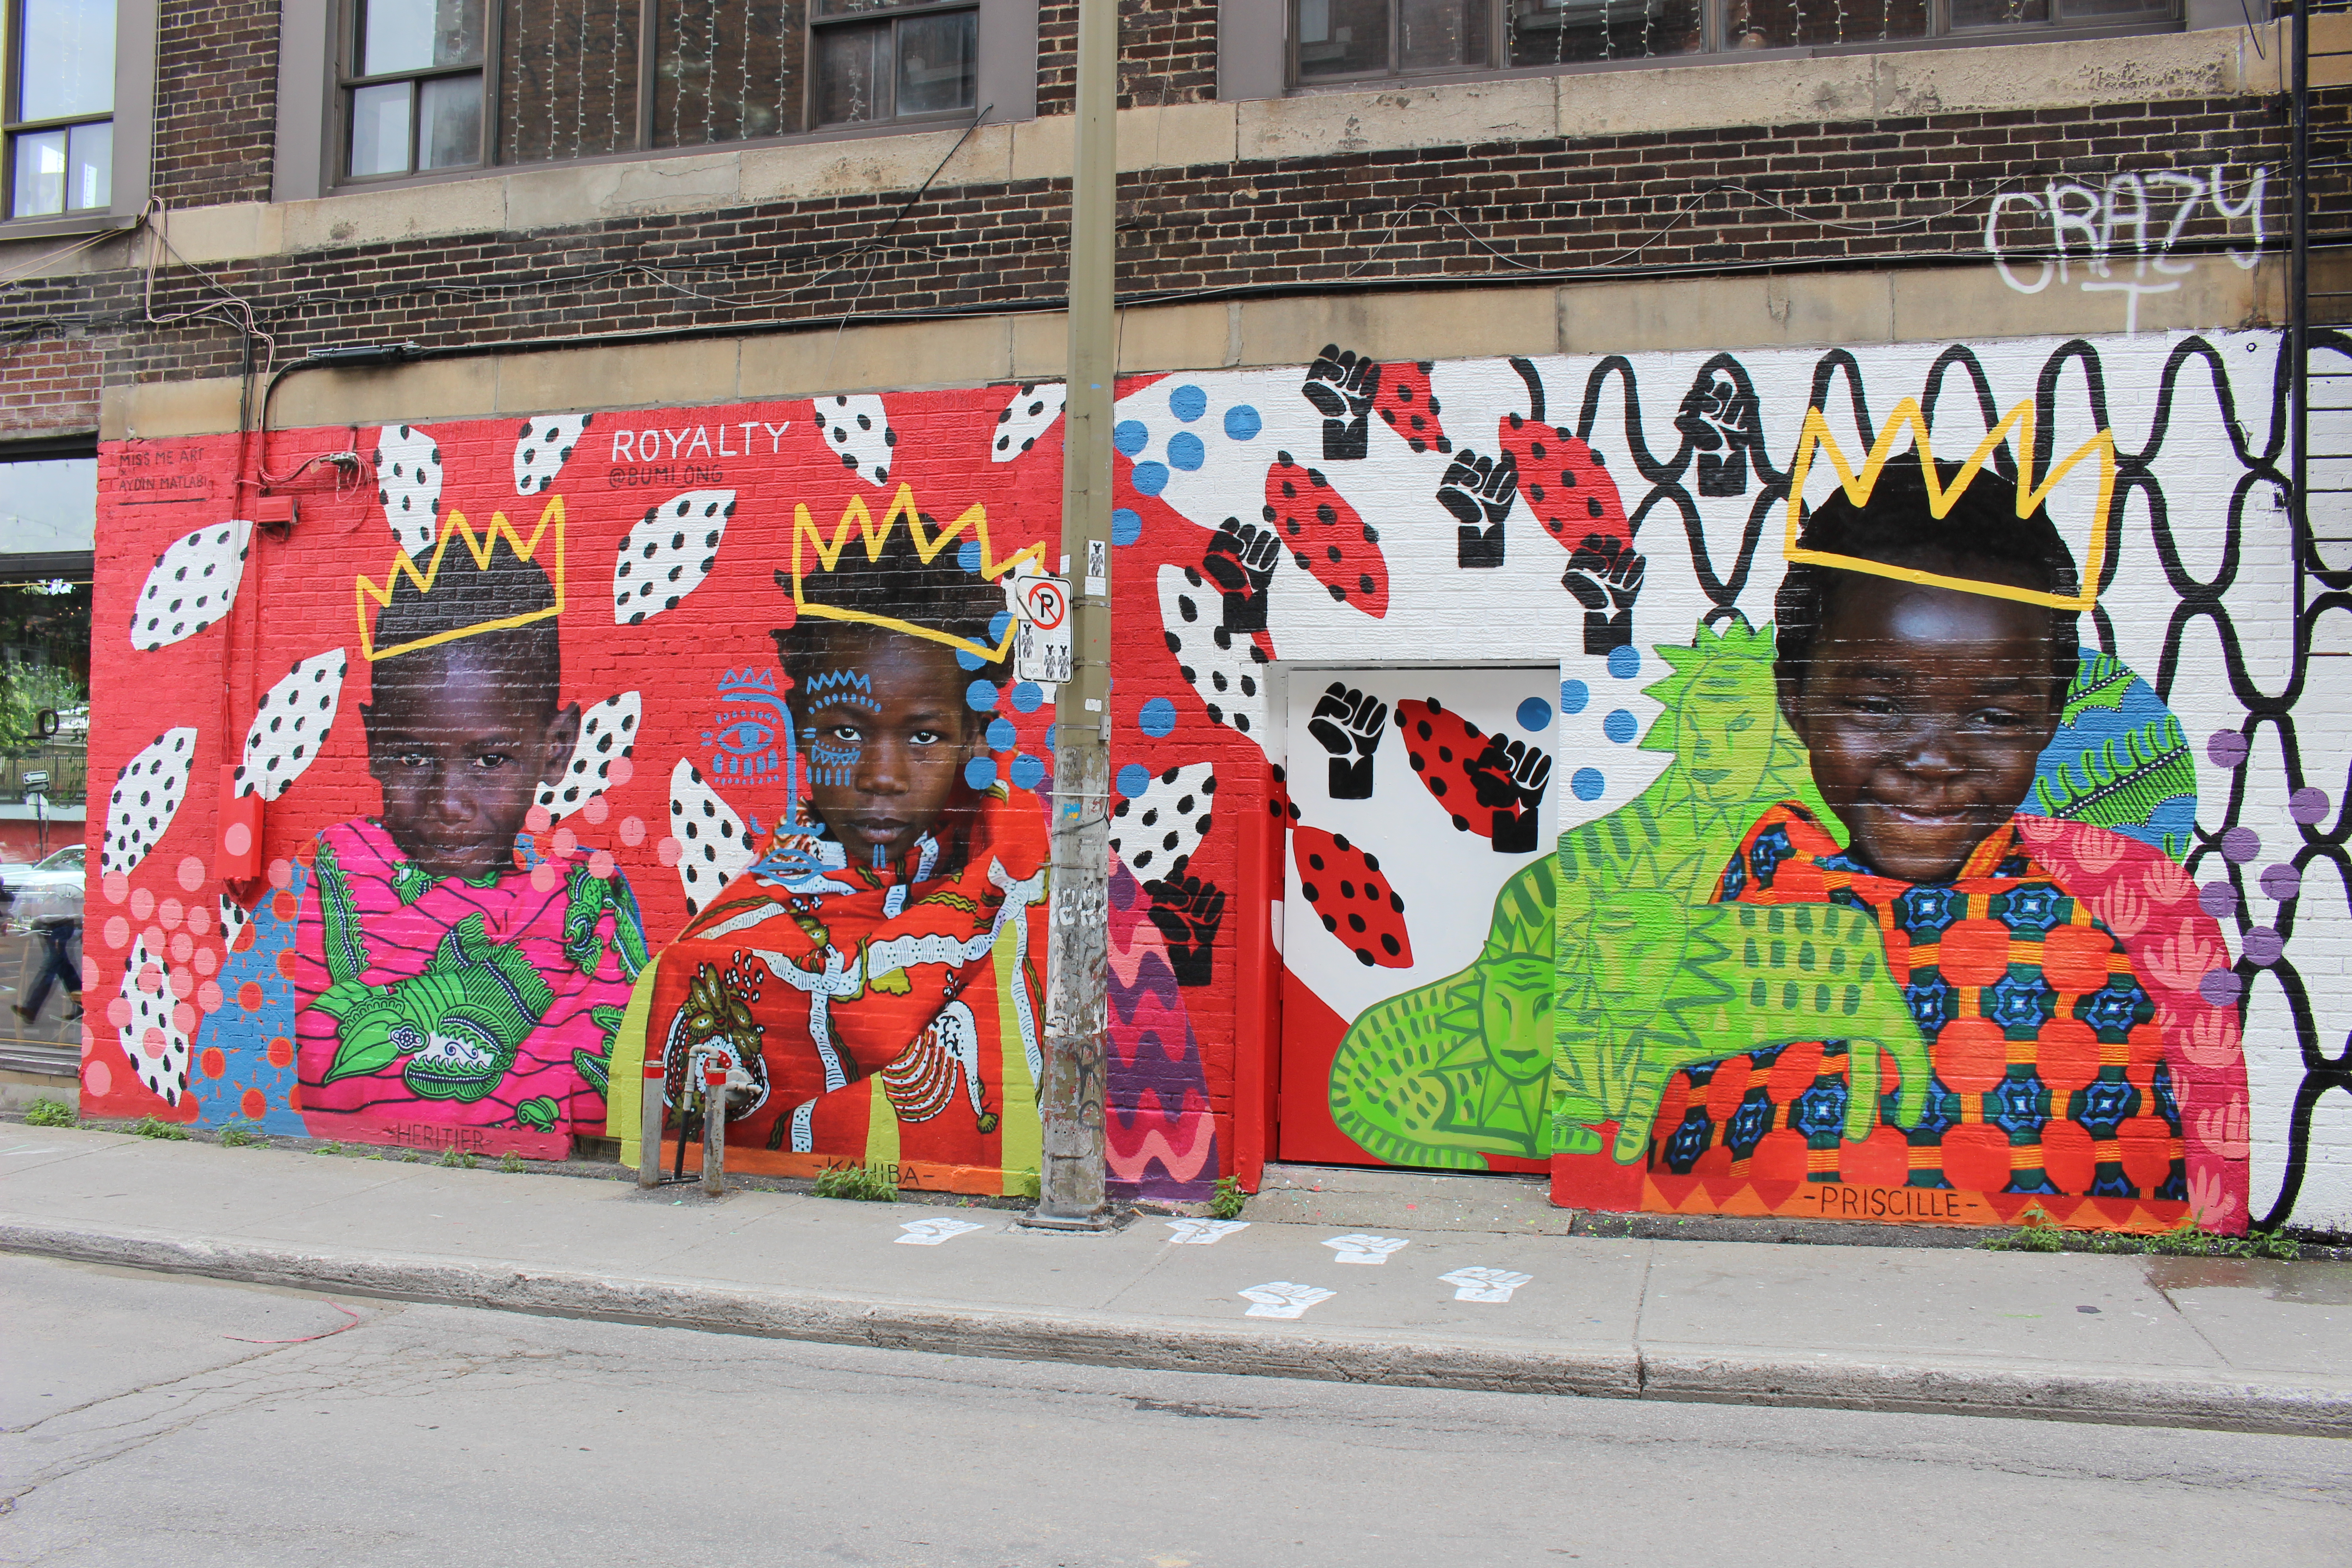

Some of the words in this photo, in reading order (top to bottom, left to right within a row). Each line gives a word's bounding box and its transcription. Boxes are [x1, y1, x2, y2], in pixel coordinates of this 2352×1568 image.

[612, 421, 790, 462] ROYALTY
[120, 453, 150, 466] MISS
[156, 451, 173, 465] ME
[180, 448, 204, 463] ART
[119, 478, 155, 491] AYDIN
